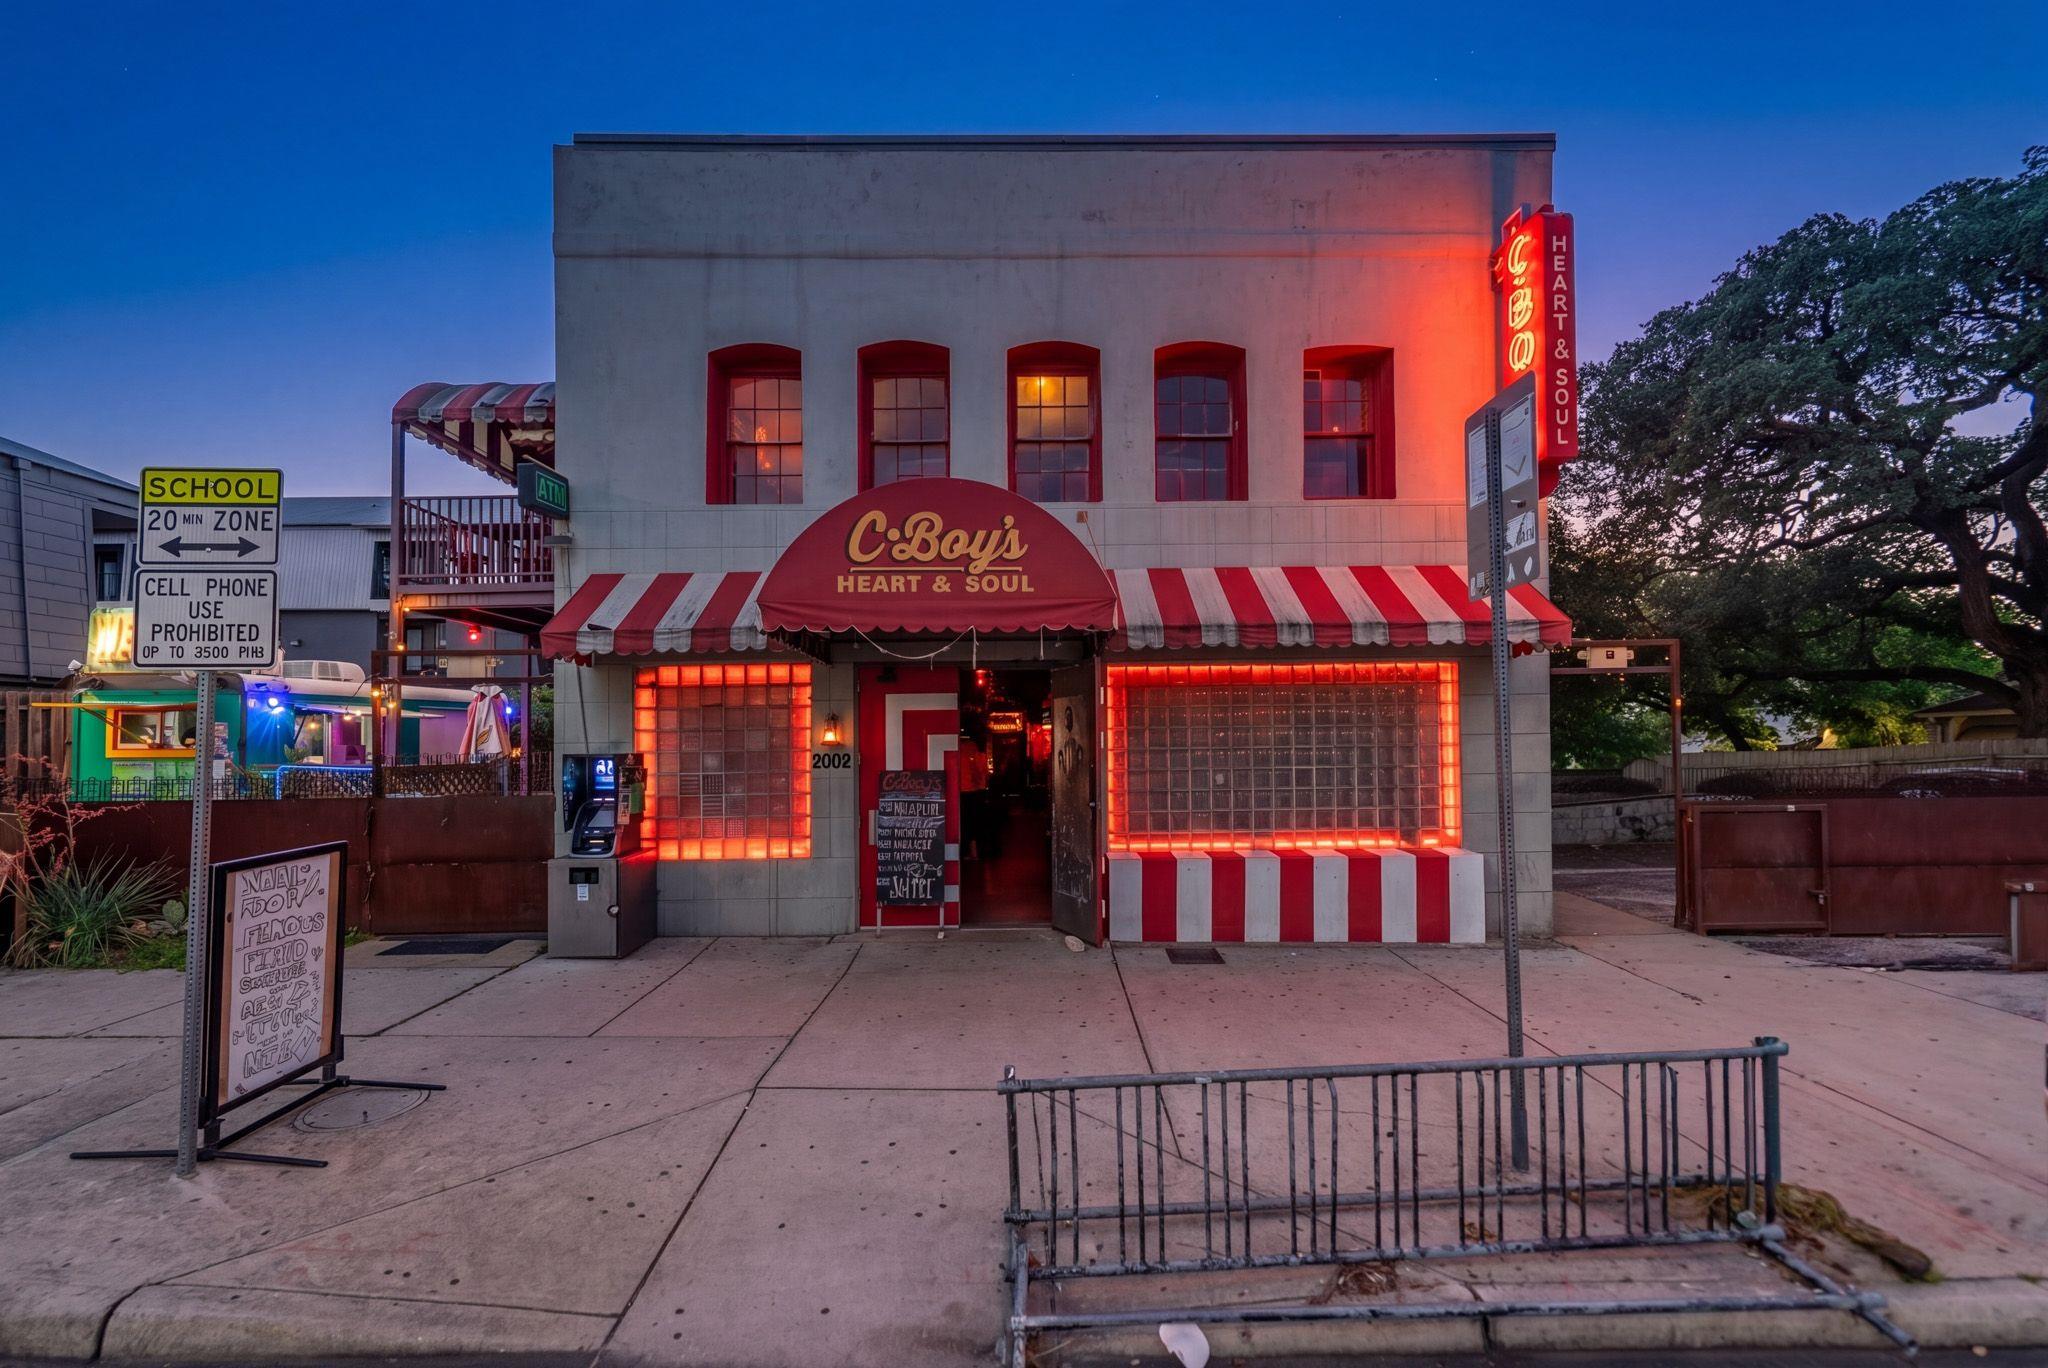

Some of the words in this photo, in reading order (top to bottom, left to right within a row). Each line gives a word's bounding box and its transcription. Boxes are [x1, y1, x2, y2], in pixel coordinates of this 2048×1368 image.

[1552, 235, 1568, 331] HEART
[1554, 338, 1570, 359] &
[1555, 368, 1570, 445] SOUL
[148, 477, 274, 499] SCHOOL
[538, 477, 565, 506] ATM
[147, 510, 177, 531] 20
[182, 513, 203, 525] MIN
[213, 510, 274, 531] ZONE
[145, 577, 190, 596] CELL
[206, 578, 268, 597] PHONE
[837, 575, 922, 593] HEART
[932, 575, 952, 593] &
[965, 575, 1035, 593] SOUL
[189, 601, 224, 619] USE
[151, 623, 259, 642] PROHIBITED
[169, 646, 184, 659] TO
[194, 646, 229, 659] 3500
[812, 753, 851, 769] 2002
